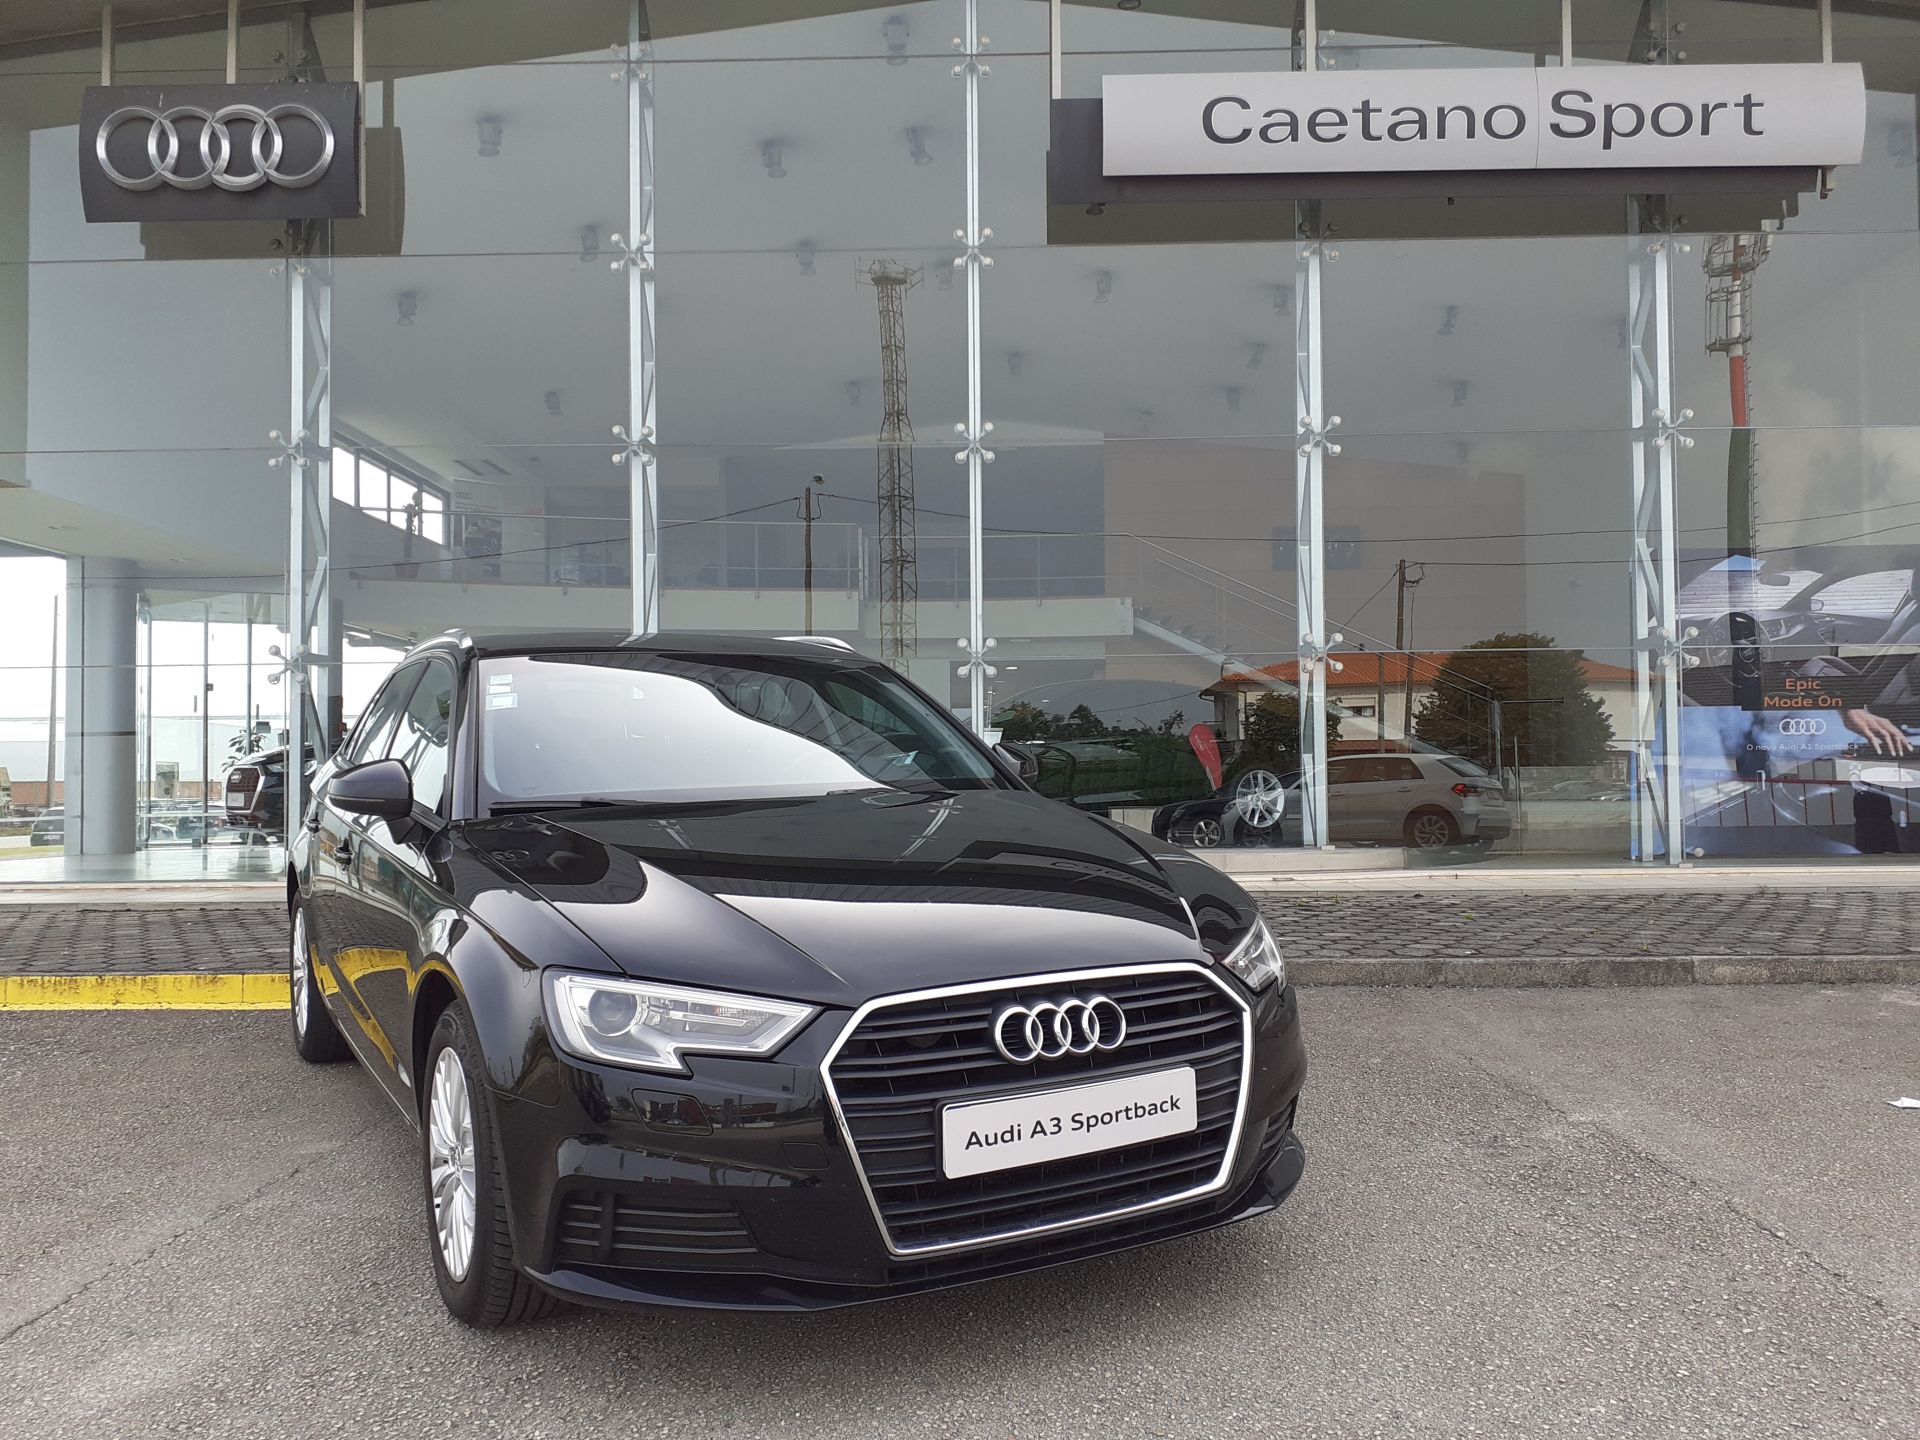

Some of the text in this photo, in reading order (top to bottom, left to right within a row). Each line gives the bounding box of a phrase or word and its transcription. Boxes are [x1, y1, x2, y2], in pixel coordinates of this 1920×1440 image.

[1200, 89, 1766, 151] Caetano Sport
[1785, 678, 1822, 692] Epic
[1763, 695, 1842, 708] Mode On
[1779, 743, 1799, 751] Audi
[1815, 742, 1859, 751] Sportback
[964, 1094, 1182, 1150] Audi A3 Sportback
